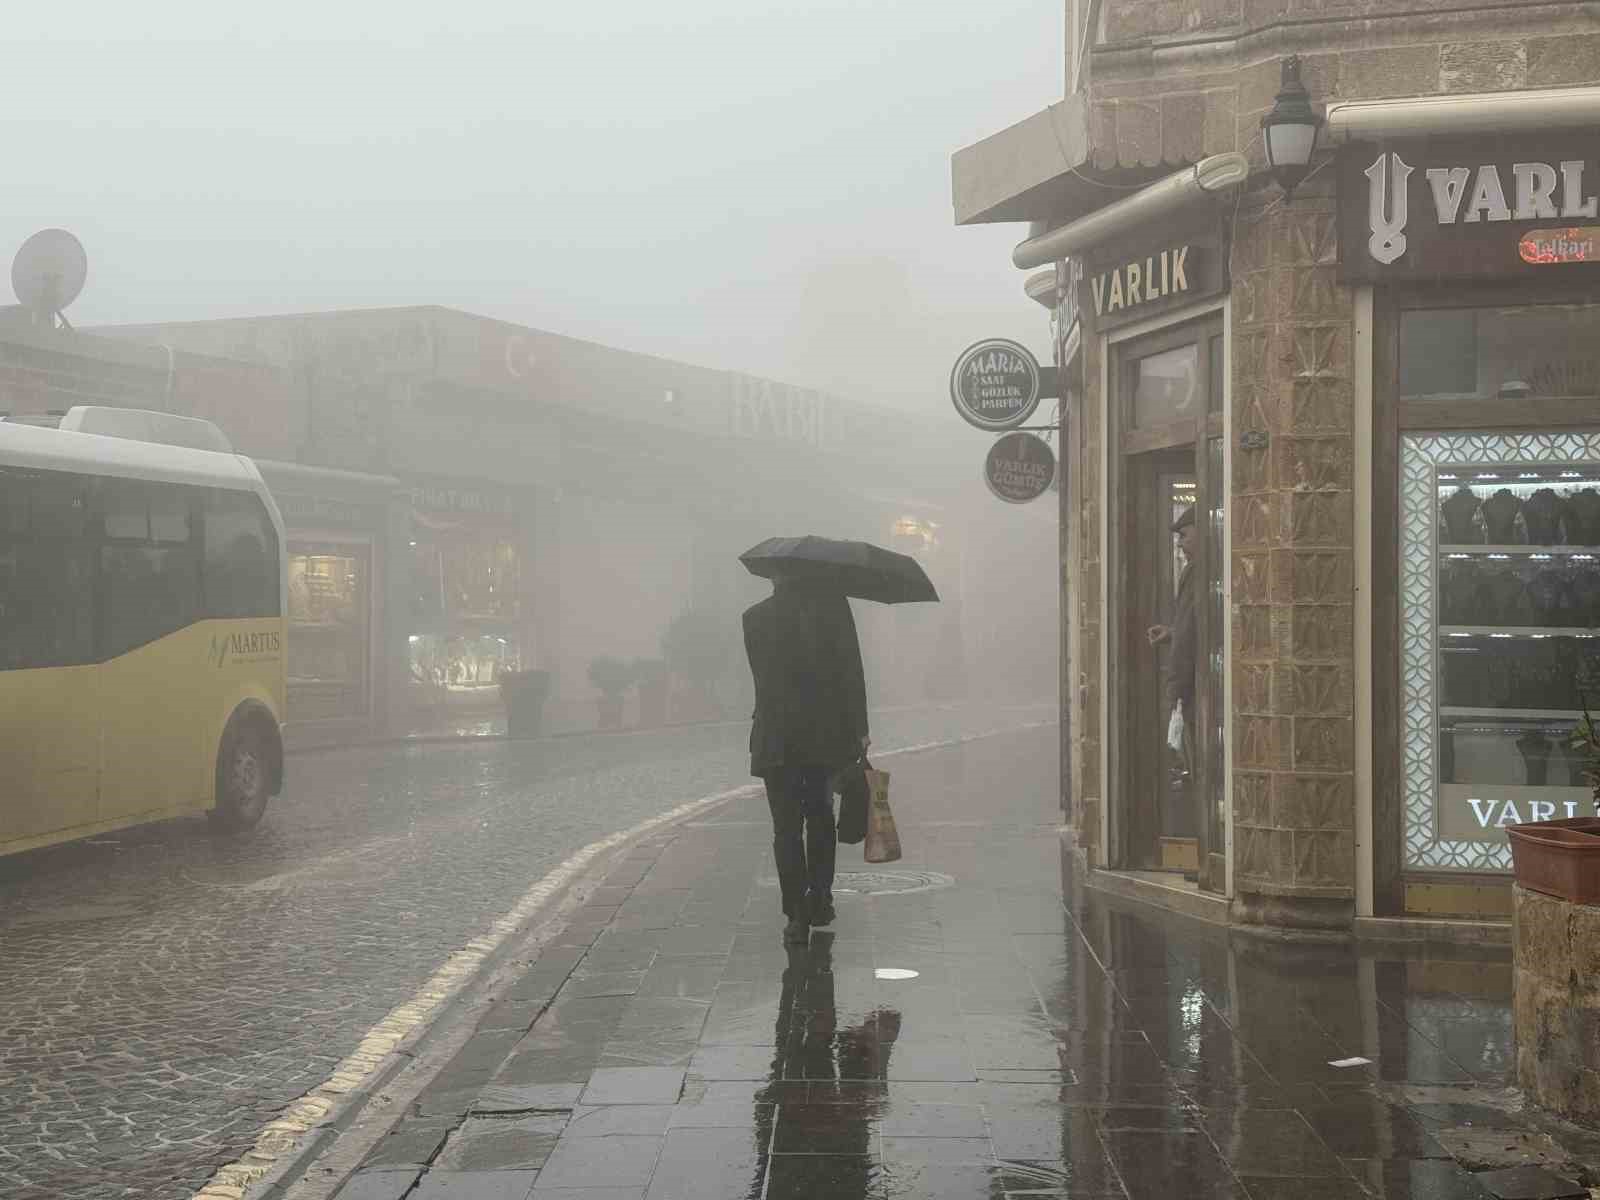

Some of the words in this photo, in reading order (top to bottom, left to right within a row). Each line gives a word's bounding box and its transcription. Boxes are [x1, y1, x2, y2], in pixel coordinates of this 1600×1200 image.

[1425, 160, 1598, 224] VARL
[1091, 245, 1190, 317] VARLIK
[231, 631, 280, 655] MARTUS
